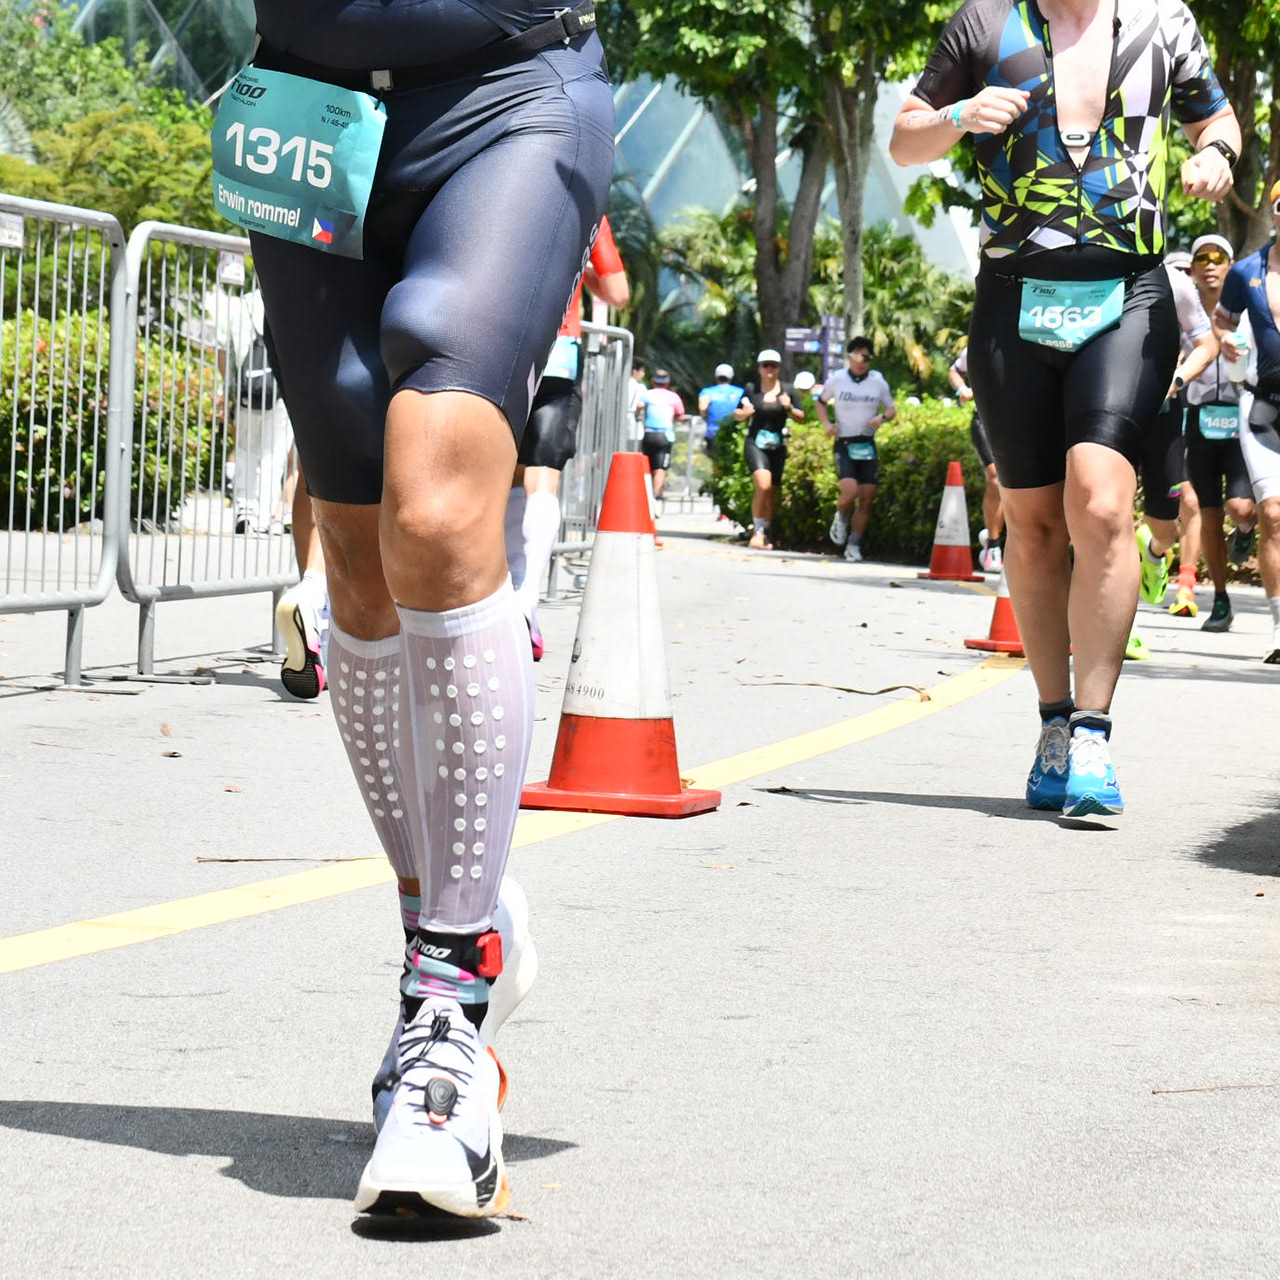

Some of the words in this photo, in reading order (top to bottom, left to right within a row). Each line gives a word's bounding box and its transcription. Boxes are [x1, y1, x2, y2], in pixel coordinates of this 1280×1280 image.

[230, 78, 268, 99] T100
[325, 104, 352, 119] 100km
[225, 121, 334, 189] 1315
[218, 182, 246, 213] Erwin
[247, 199, 301, 228] rommel
